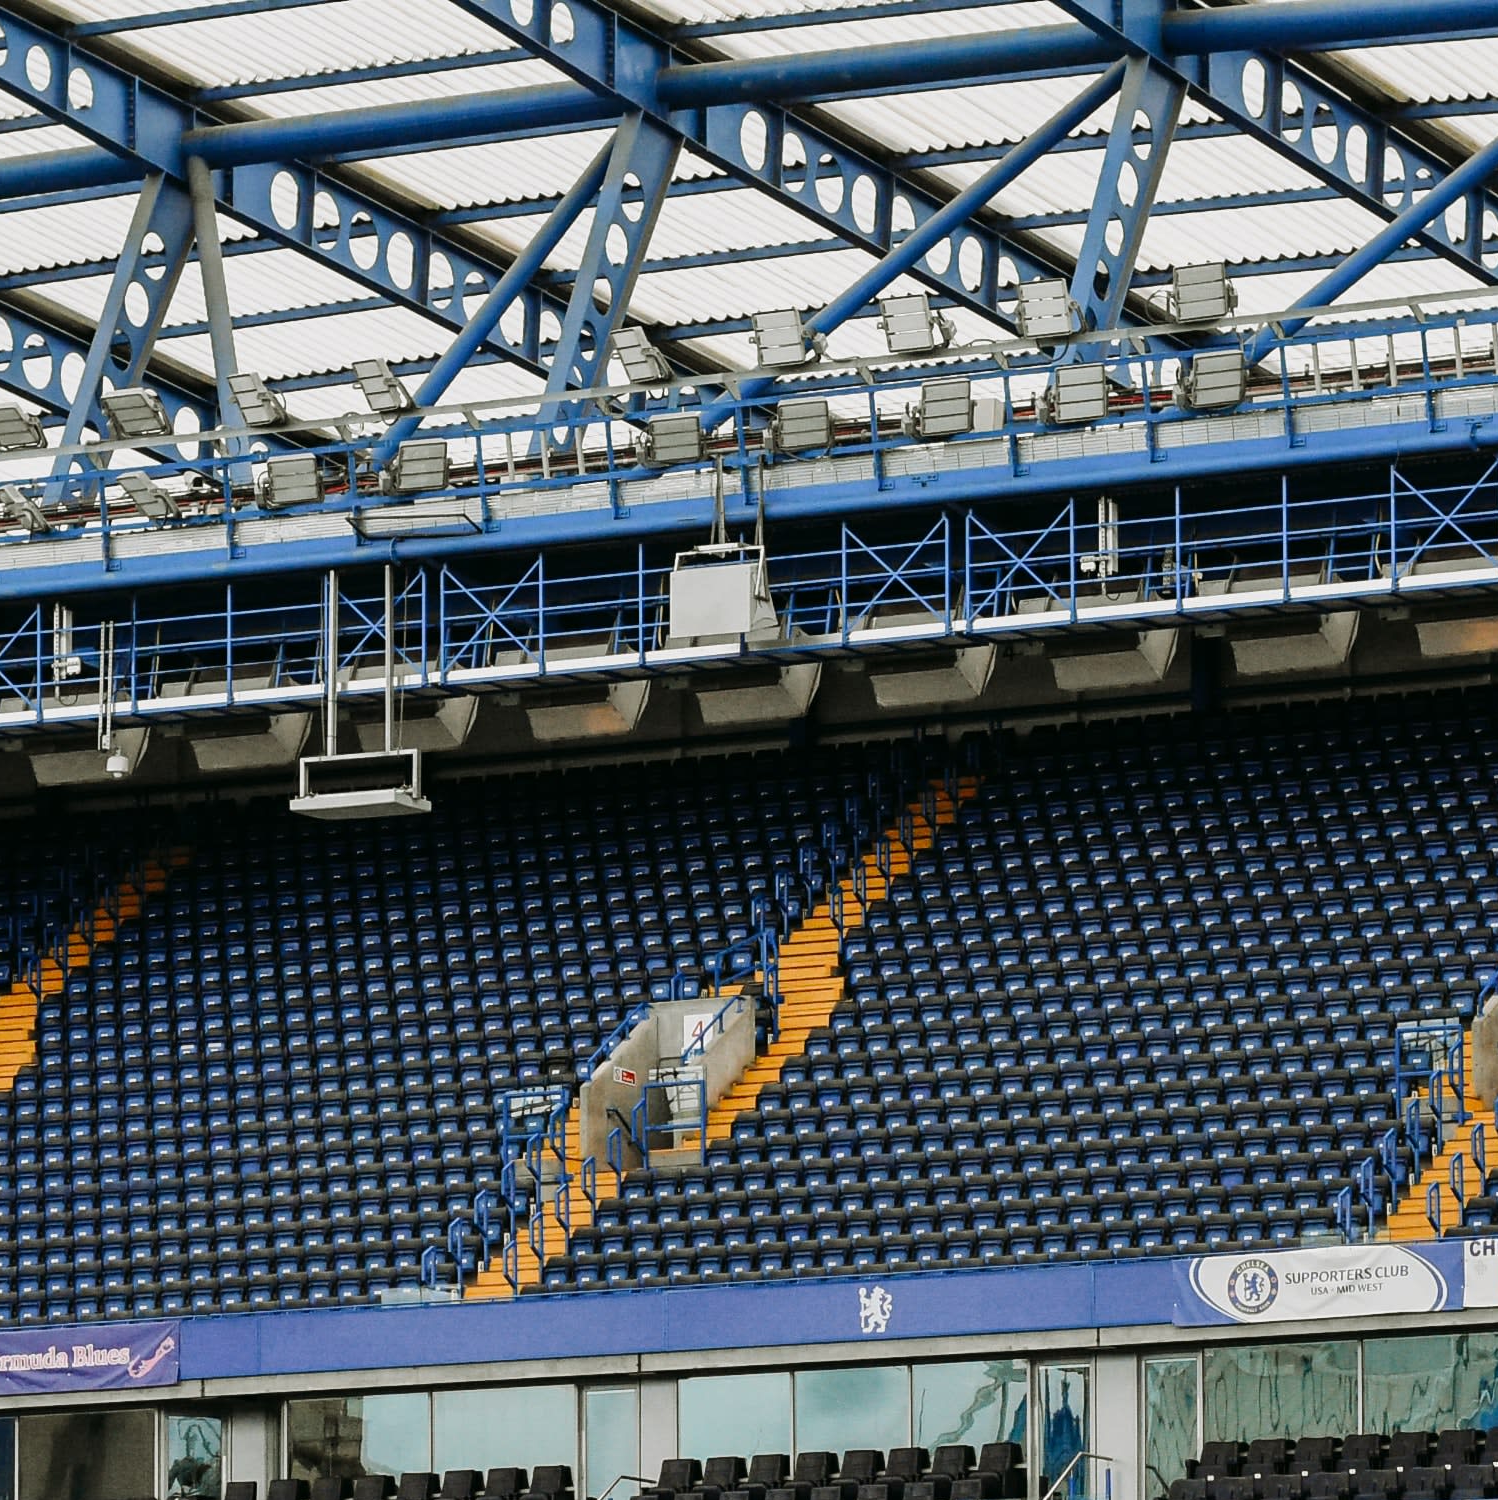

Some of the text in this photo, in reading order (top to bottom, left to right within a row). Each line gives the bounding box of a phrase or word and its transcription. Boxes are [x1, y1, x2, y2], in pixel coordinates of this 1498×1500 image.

[1235, 1259, 1271, 1275] CHELSEA
[1284, 1265, 1409, 1285] SUPPORTERS CLUB
[1310, 1283, 1384, 1296] USA MID WEST
[71, 1343, 131, 1369] Blues
